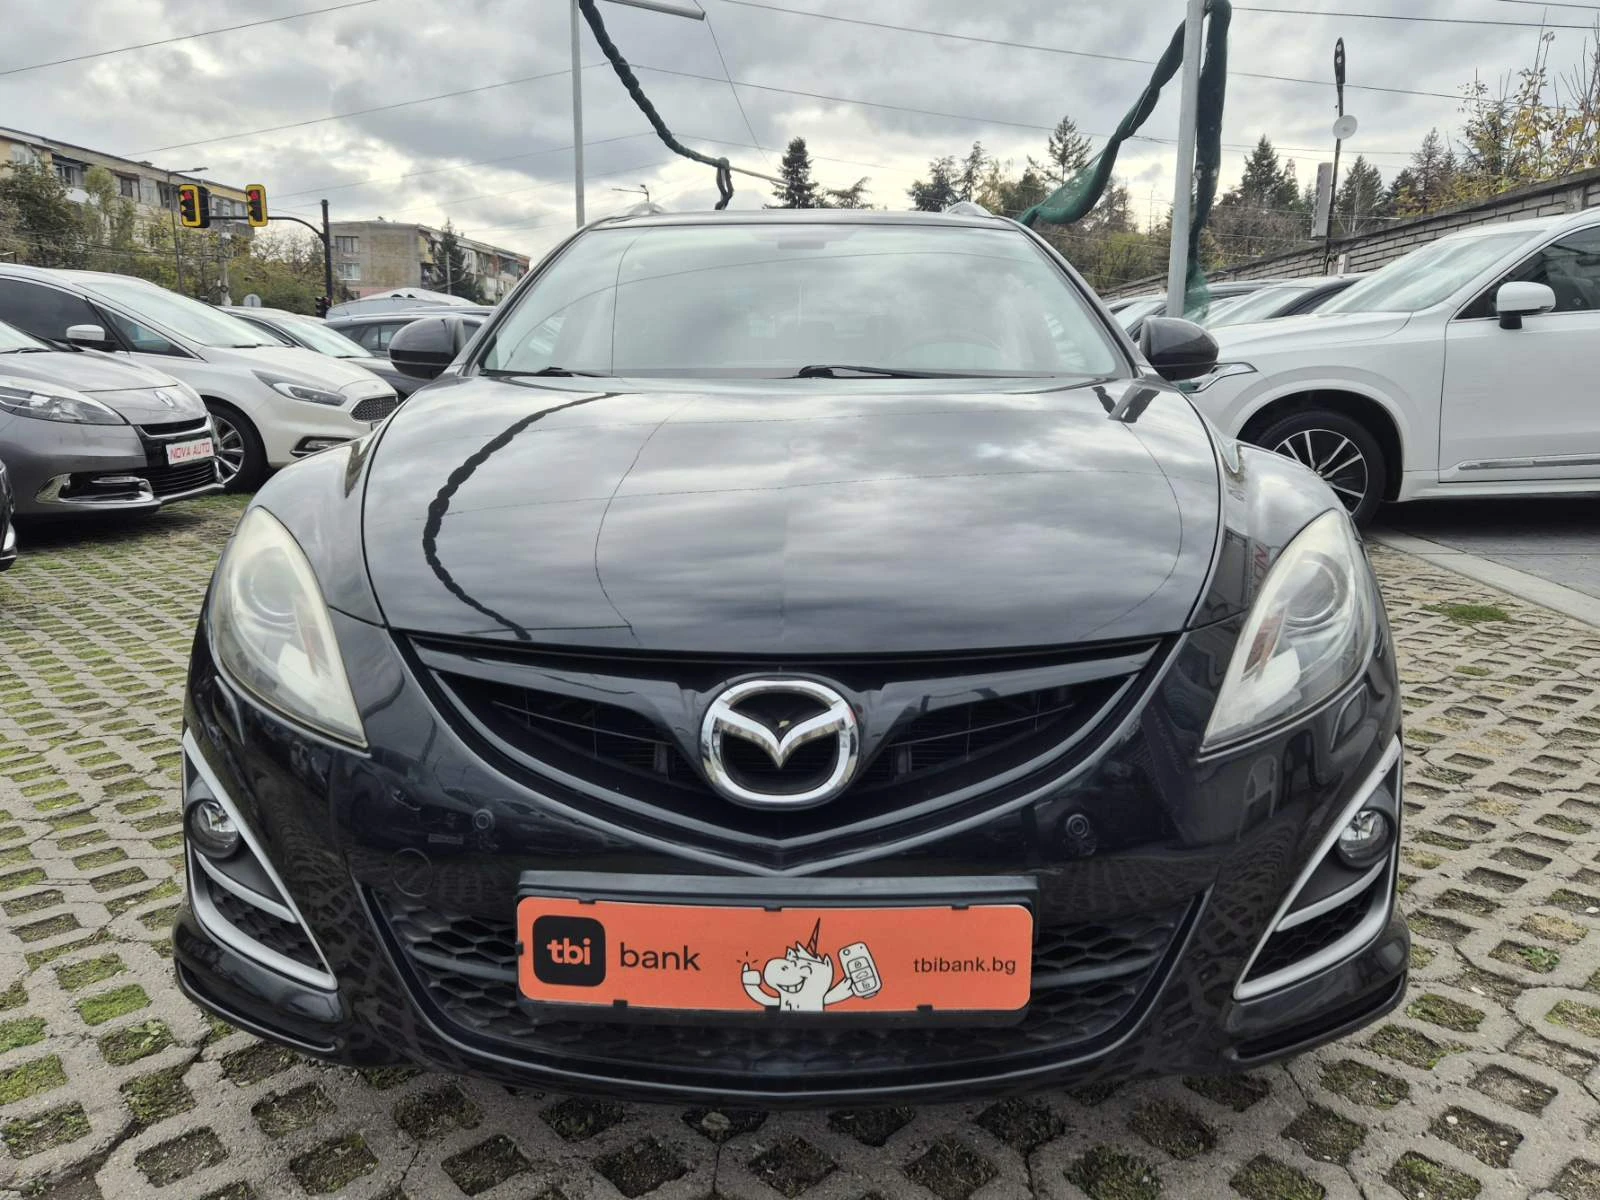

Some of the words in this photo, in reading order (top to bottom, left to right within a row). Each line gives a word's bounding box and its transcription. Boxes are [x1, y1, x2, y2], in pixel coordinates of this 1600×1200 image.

[170, 445, 191, 460] NOVA
[192, 442, 211, 456] AUTO
[546, 937, 591, 965] tbi
[619, 941, 701, 972] bank
[913, 956, 1016, 976] tbibank.bg
